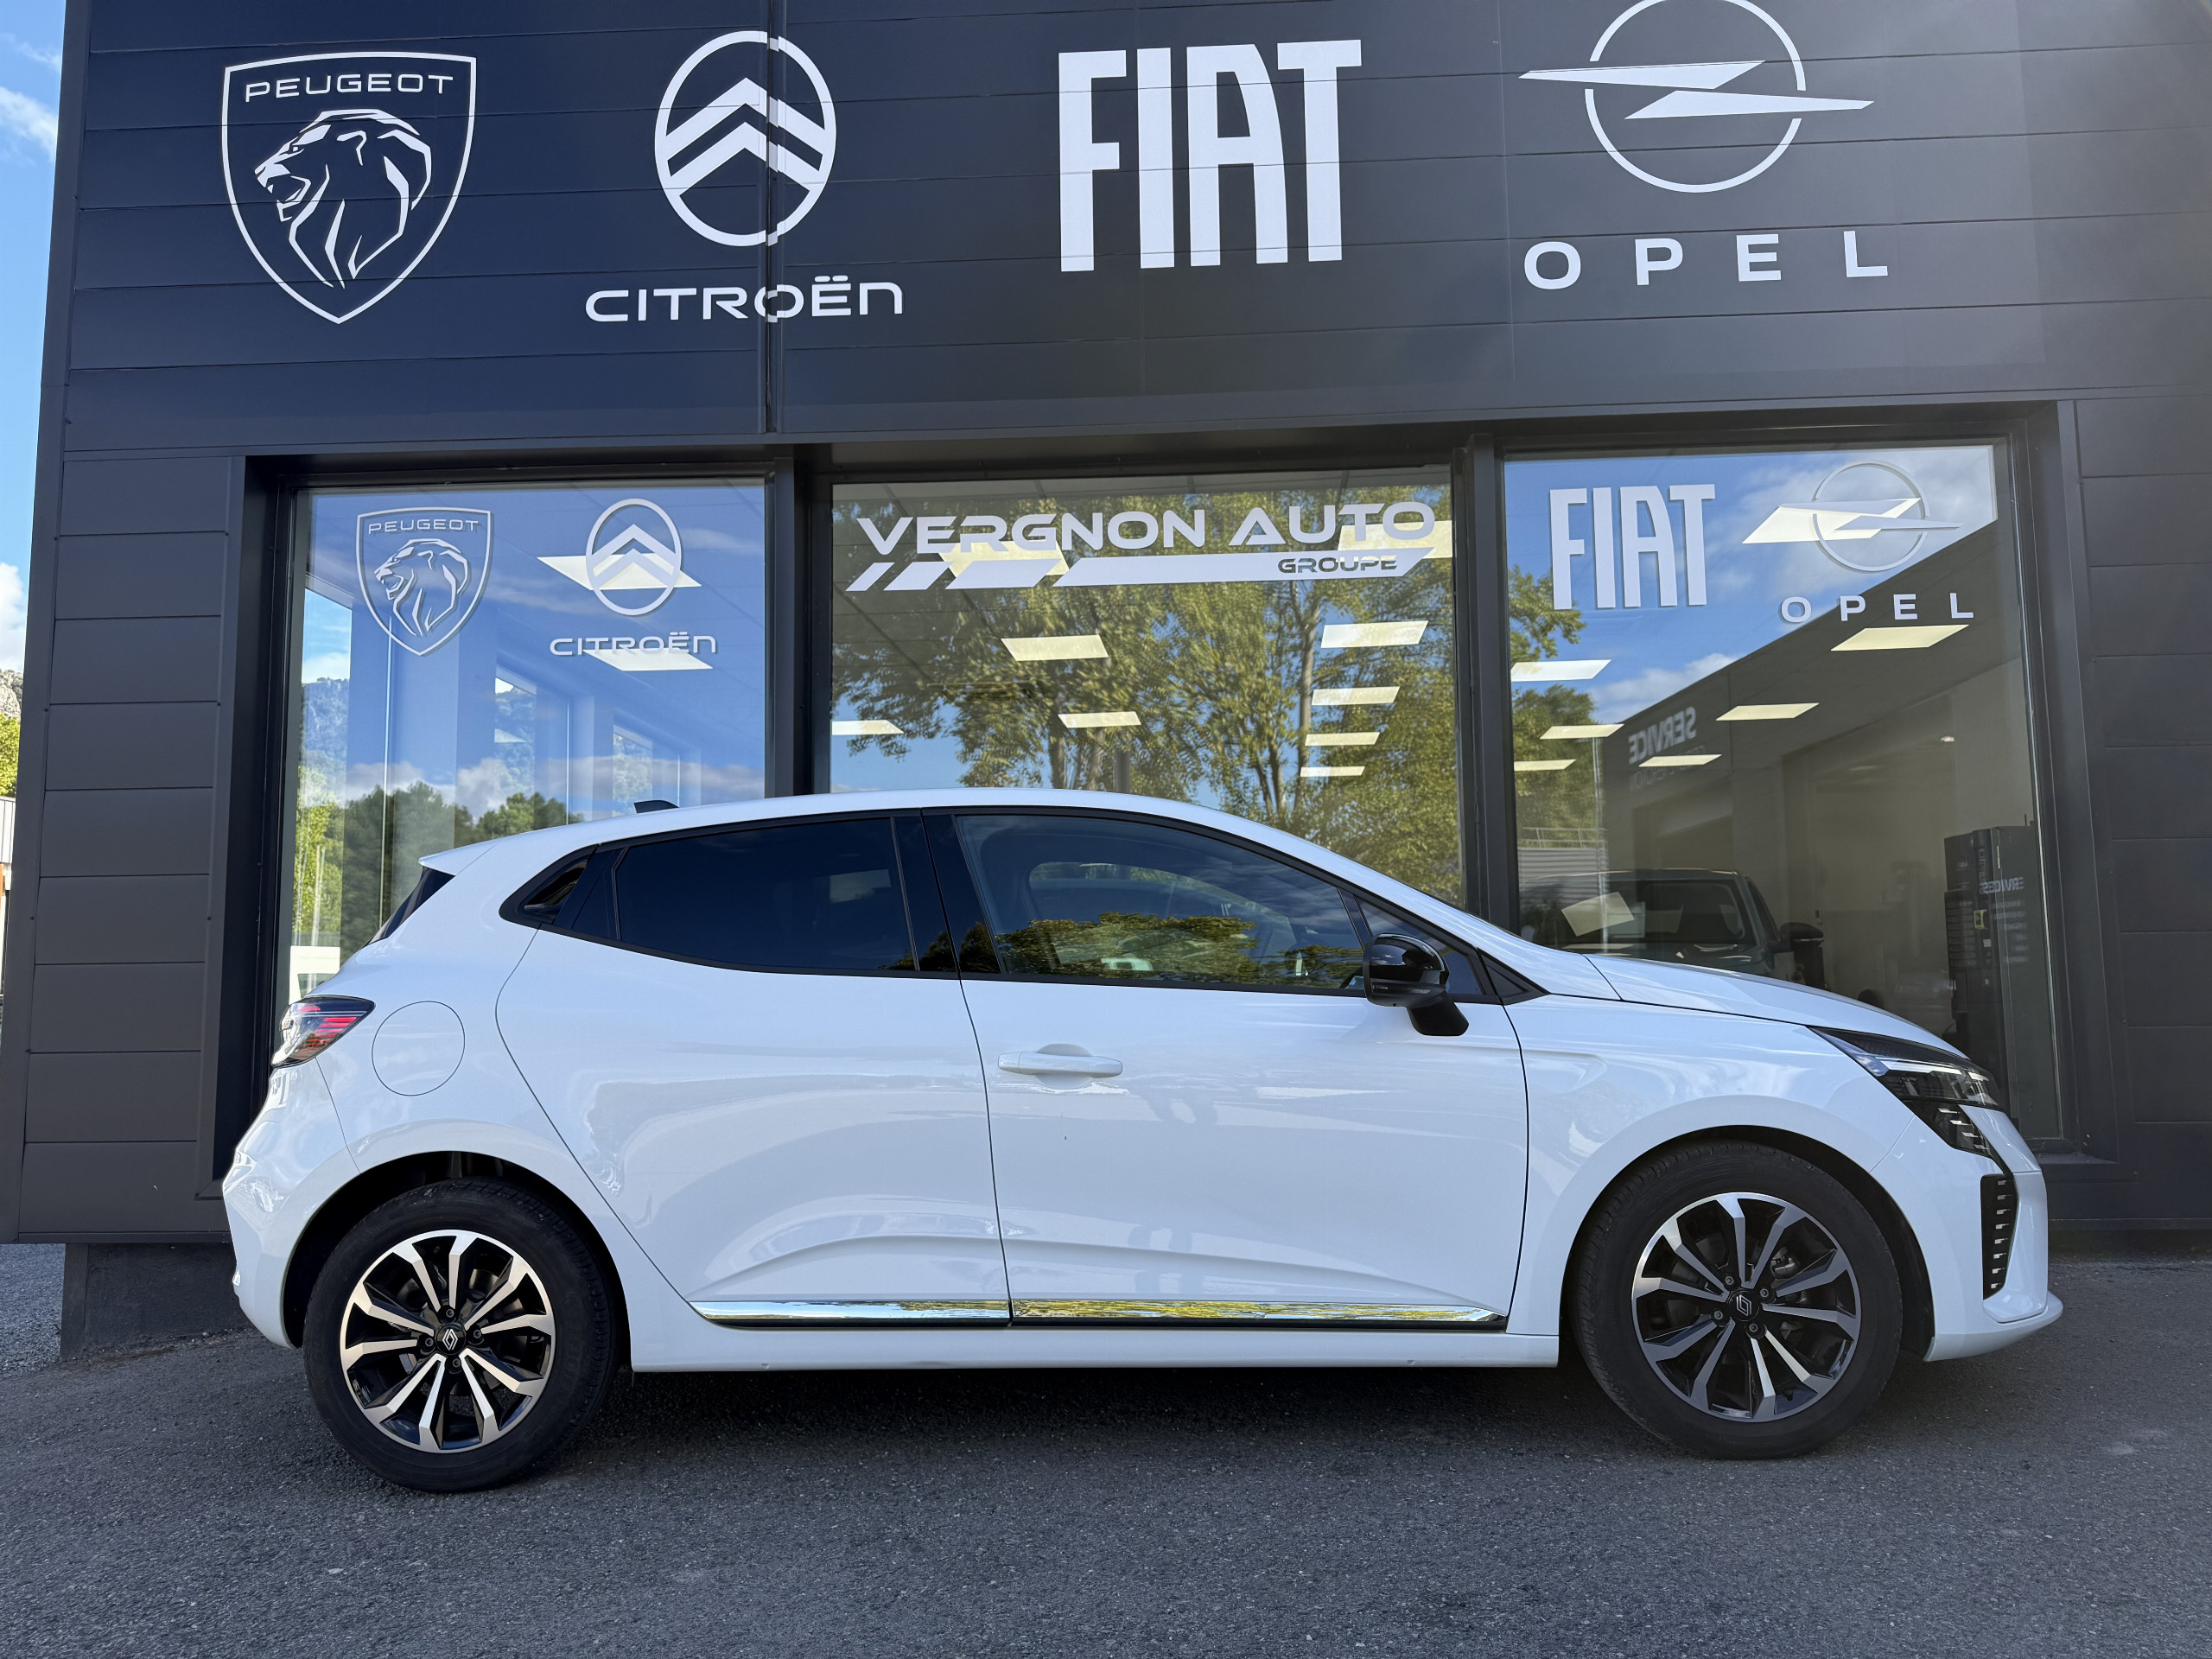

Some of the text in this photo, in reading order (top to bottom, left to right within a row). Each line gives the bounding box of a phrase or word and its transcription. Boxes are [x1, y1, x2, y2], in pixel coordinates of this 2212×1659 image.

[245, 73, 454, 103] PEUGEOT
[1058, 39, 1363, 272] FIAT
[1524, 230, 1889, 290] OPEL
[585, 275, 903, 323] CITROËN
[368, 518, 479, 535] PEUGEOT
[856, 501, 1435, 556] VERGNON AUTO
[1277, 555, 1397, 574] GROUPE
[1549, 483, 1716, 611] FIAT
[1780, 592, 1974, 624] OPEL
[550, 631, 716, 657] CITROËN
